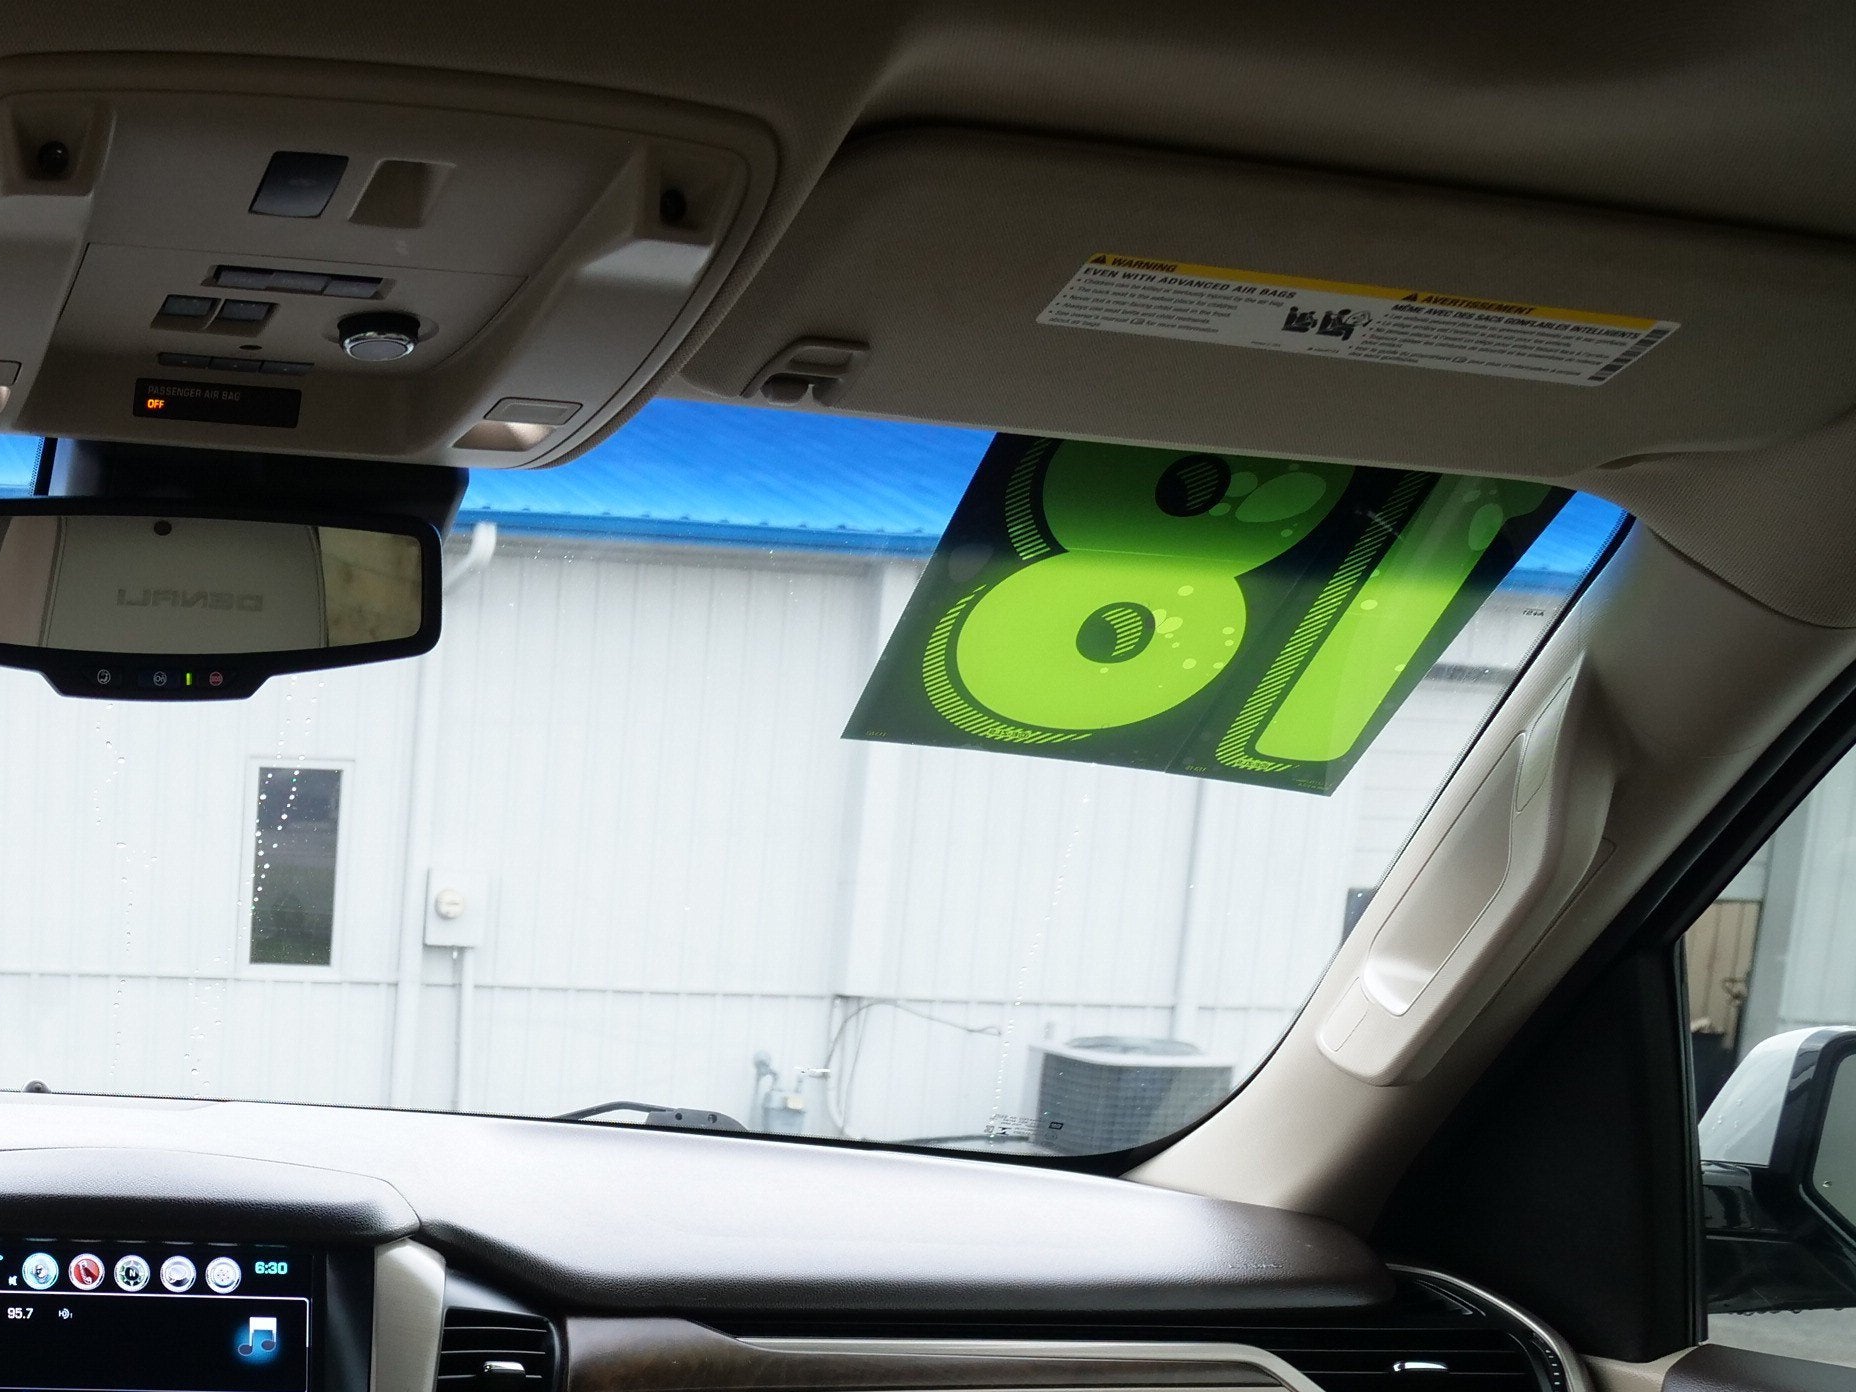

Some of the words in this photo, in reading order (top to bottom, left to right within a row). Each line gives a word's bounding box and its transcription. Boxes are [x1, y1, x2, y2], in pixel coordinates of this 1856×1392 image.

[1111, 257, 1177, 273] WARNING
[1083, 267, 1119, 278] EVEN
[1121, 271, 1155, 282] WITH
[1158, 276, 1230, 291] ADVANCED
[1232, 285, 1256, 294] AIR
[1259, 288, 1296, 299] BAGS
[1424, 306, 1452, 318] AVEC
[1453, 310, 1475, 320] DES
[148, 386, 201, 397] PASSENGER
[204, 390, 219, 398] AIR
[222, 390, 240, 400] BAG
[147, 399, 164, 409] OFF
[254, 1261, 288, 1275] 6:30
[6, 1307, 34, 1320] 95.7
